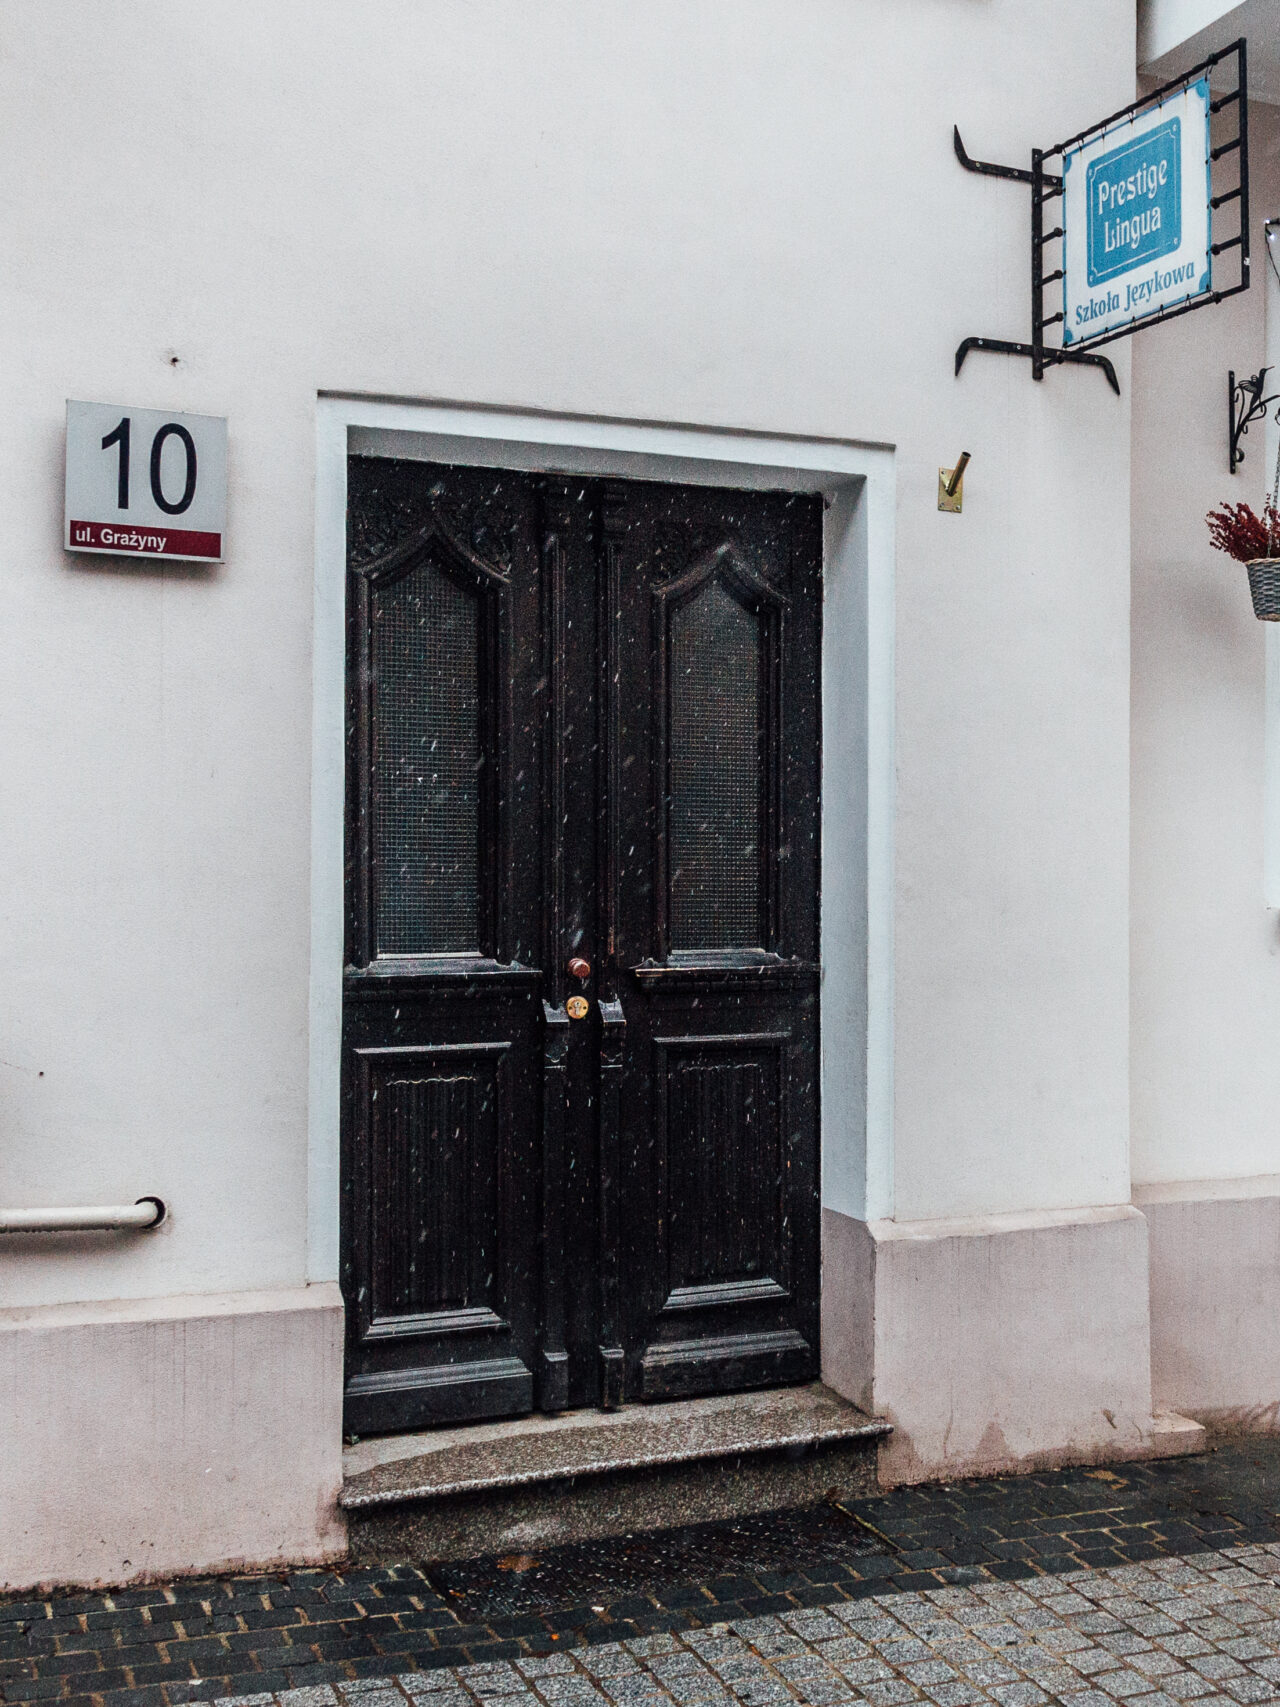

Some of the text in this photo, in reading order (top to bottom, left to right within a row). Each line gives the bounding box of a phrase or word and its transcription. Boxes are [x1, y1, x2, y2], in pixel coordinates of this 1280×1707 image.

[1098, 159, 1167, 214] Prestige
[1104, 206, 1161, 252] Lingua
[1075, 261, 1195, 326] Szkoła Językowa
[102, 417, 197, 515] 10
[75, 527, 167, 552] ul. Grażyny
